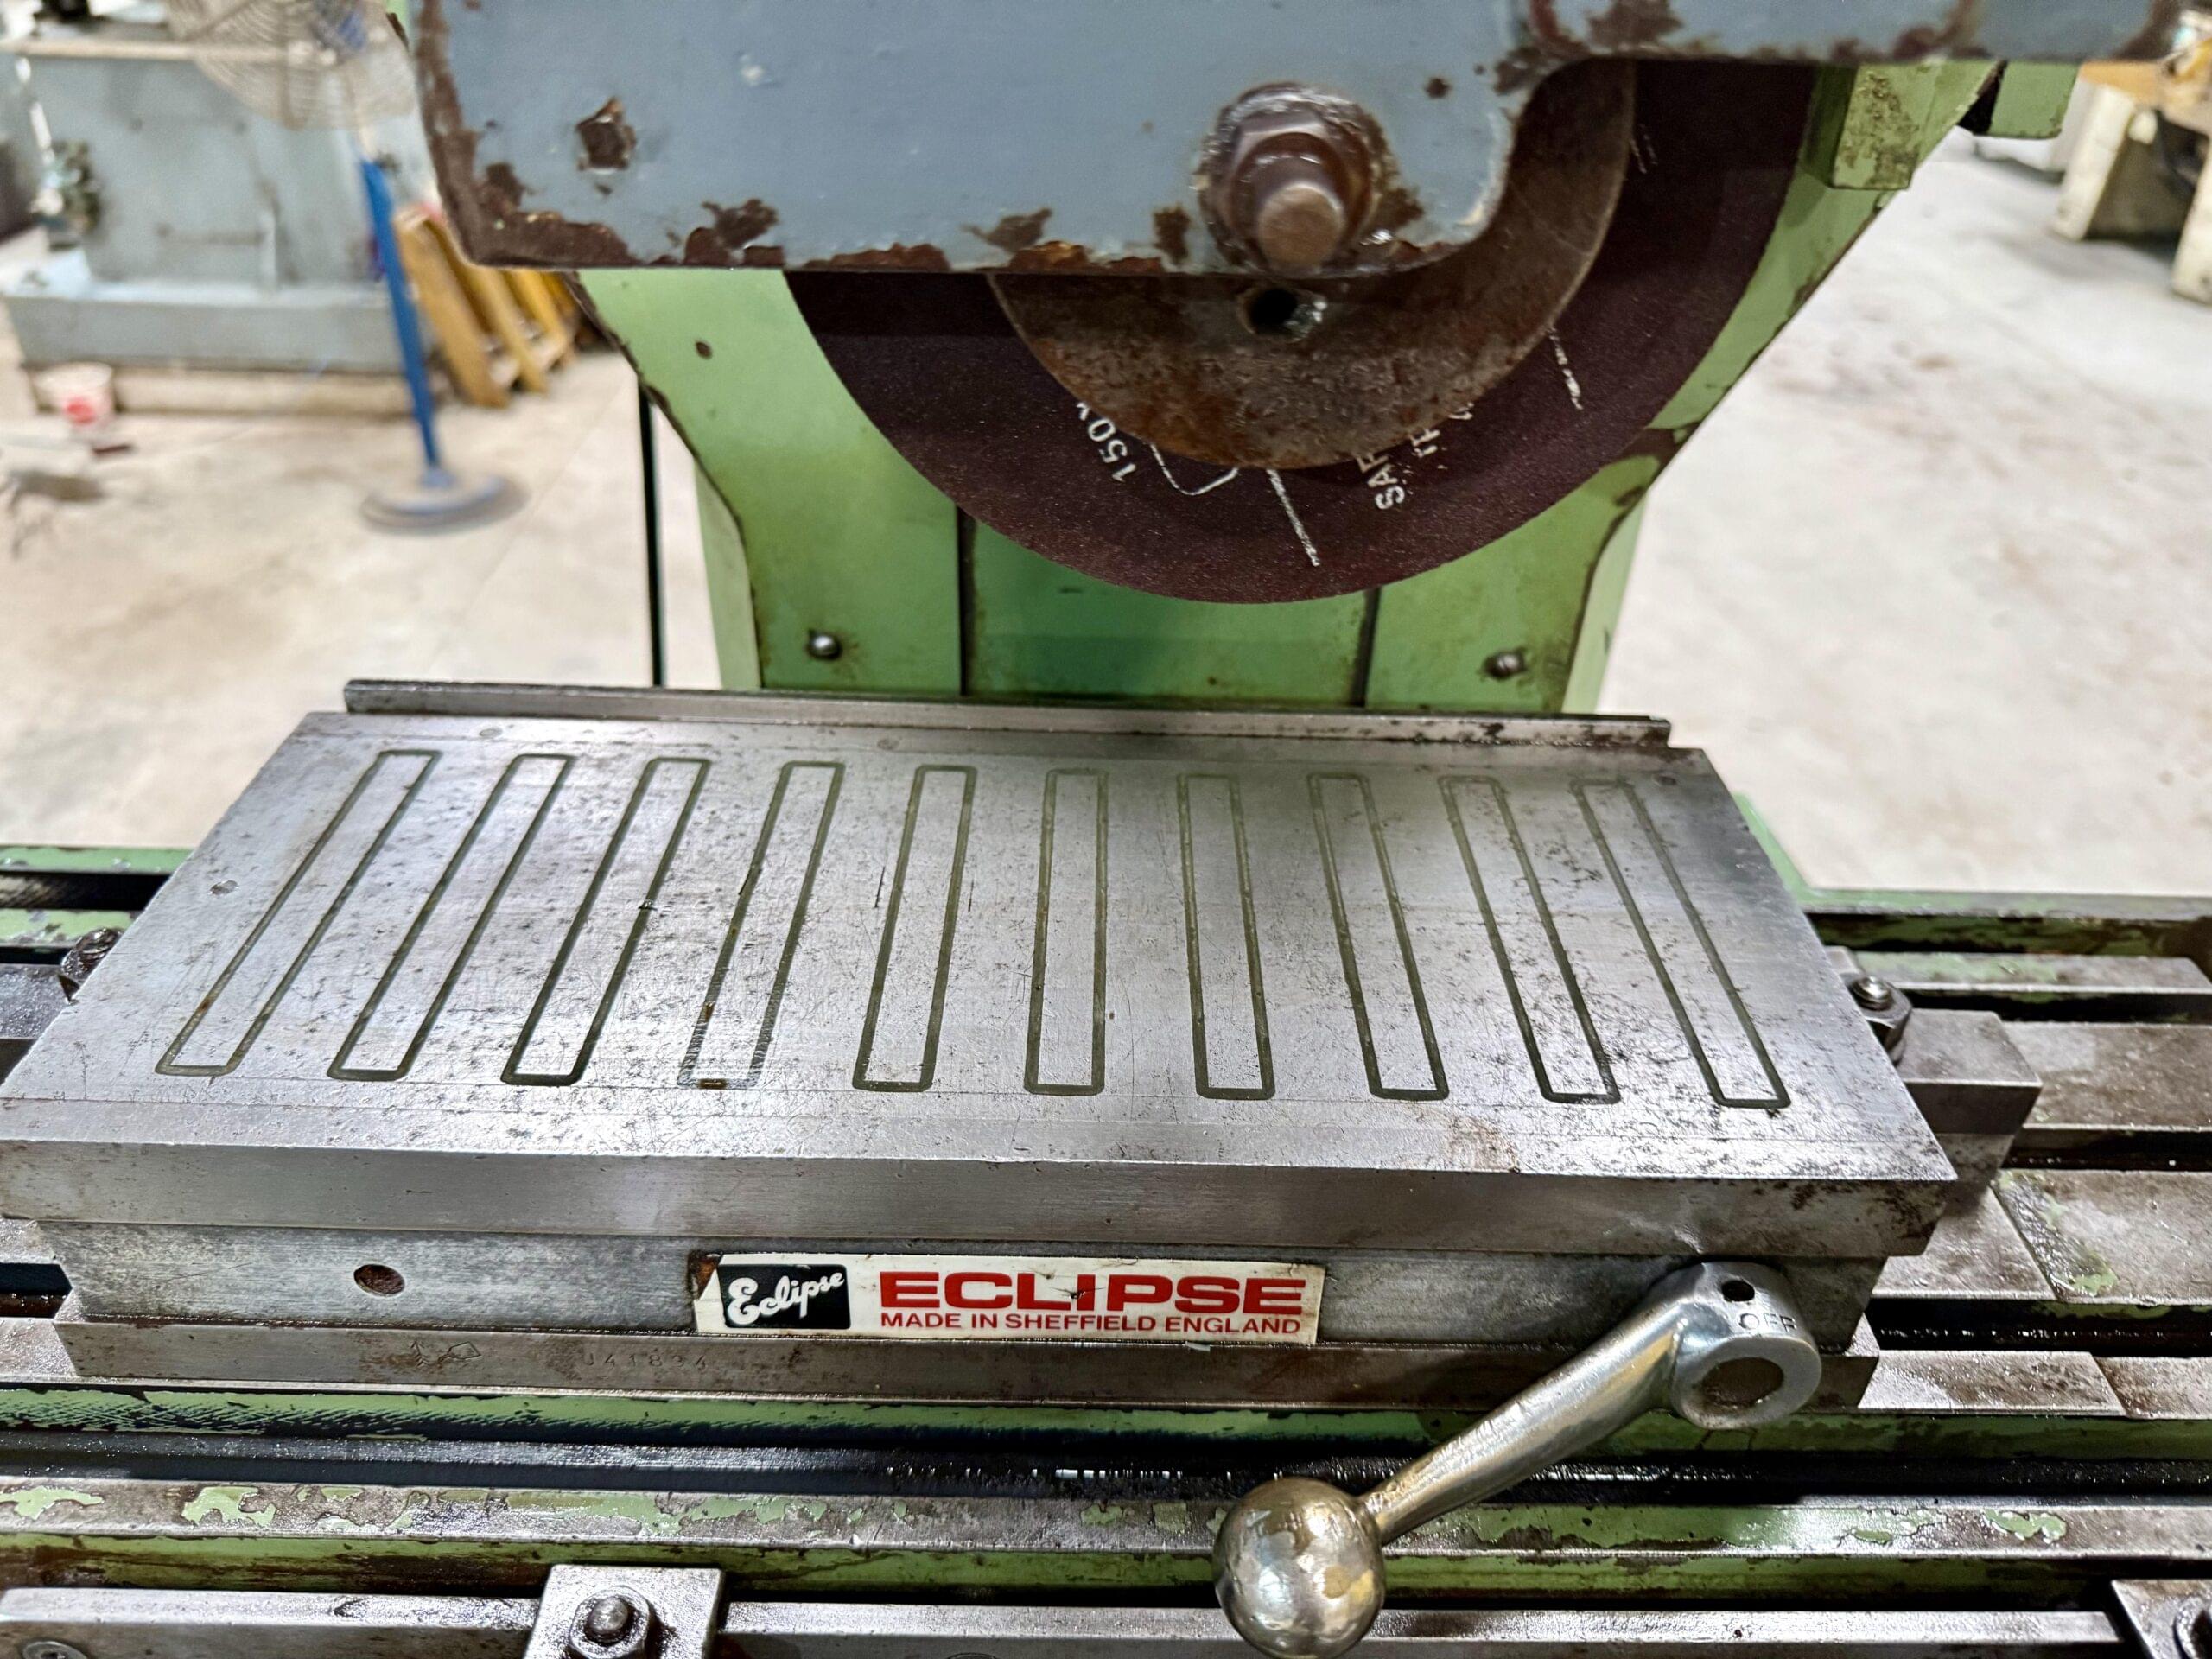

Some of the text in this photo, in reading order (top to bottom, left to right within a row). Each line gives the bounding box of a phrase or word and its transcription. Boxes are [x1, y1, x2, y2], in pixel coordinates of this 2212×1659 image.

[728, 1272, 845, 1325] Eclipse
[880, 1271, 1306, 1314] ECLIPSE
[880, 1313, 1301, 1334] MADE IN SHEFFIELD ENGLAND
[1739, 1313, 1797, 1333] OFF
